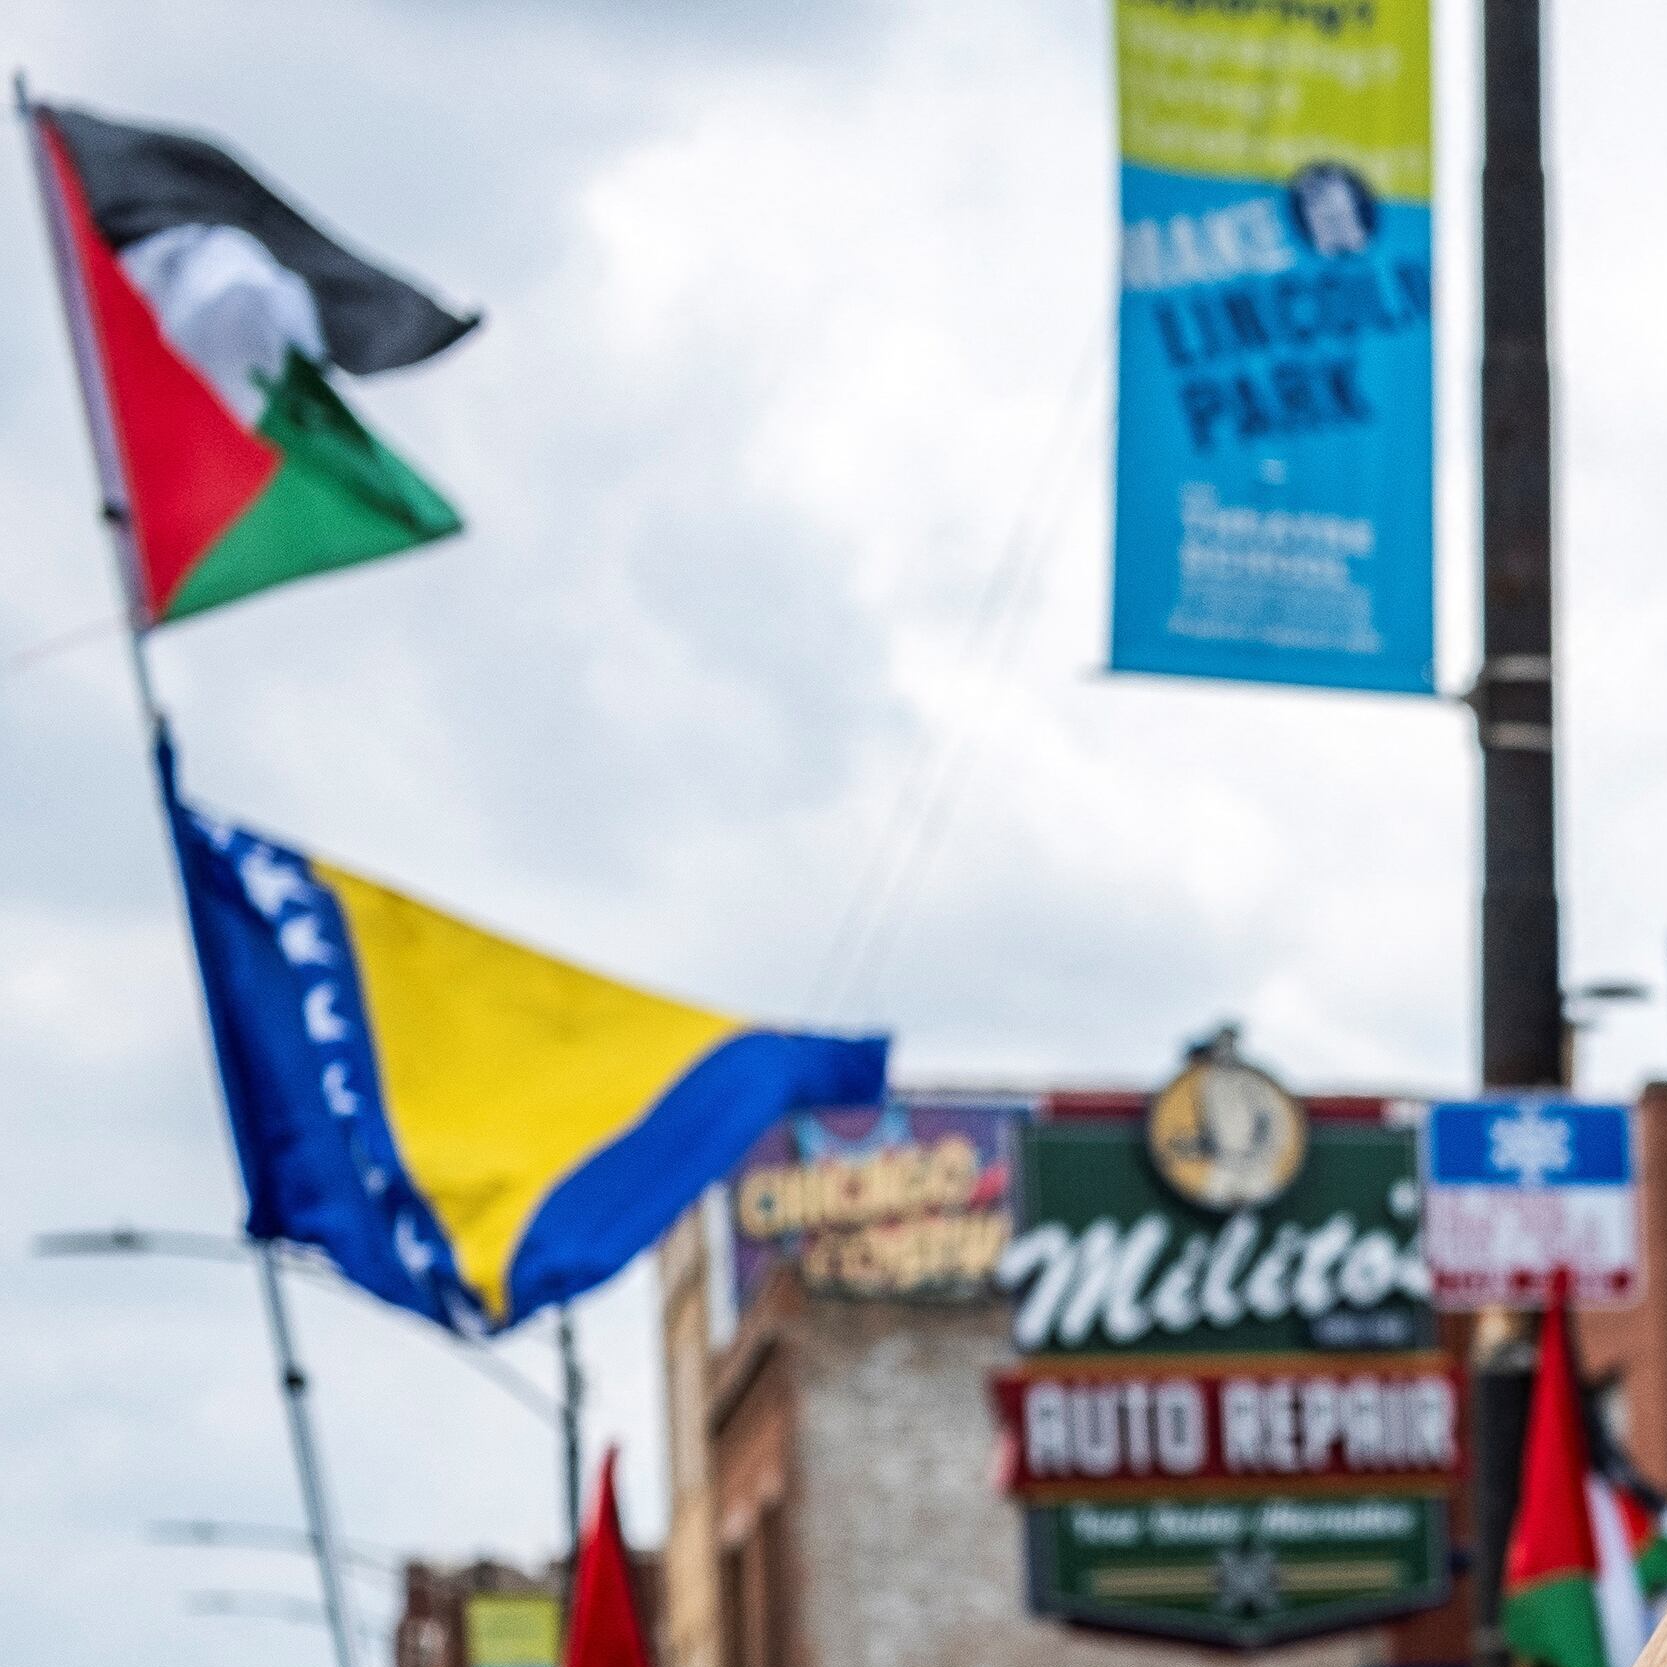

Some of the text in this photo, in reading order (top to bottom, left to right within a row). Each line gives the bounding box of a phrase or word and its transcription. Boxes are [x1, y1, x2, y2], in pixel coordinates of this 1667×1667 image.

[1182, 362, 1372, 455] PARK
[1025, 1377, 1456, 1476] AUTO REPAIR
